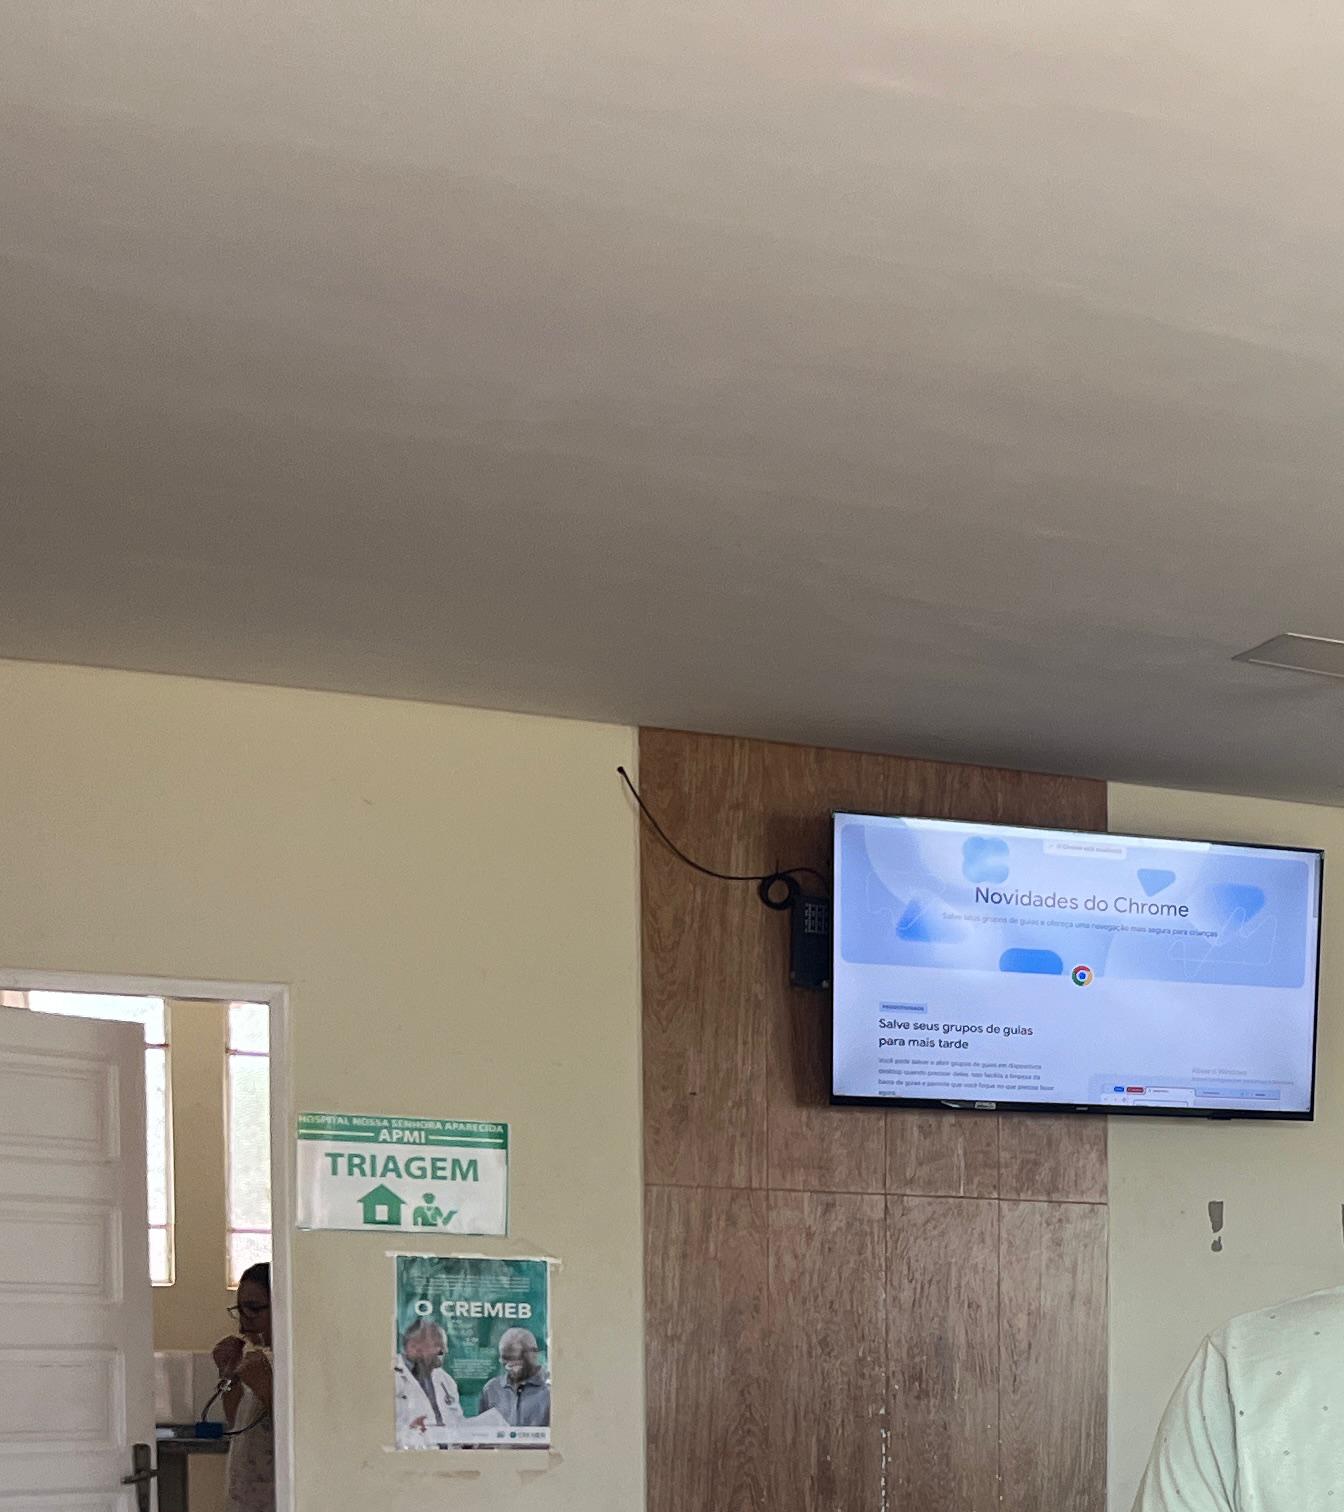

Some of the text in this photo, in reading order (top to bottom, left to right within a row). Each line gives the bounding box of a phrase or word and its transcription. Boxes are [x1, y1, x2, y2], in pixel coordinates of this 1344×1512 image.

[975, 887, 1189, 918] Novidades do Chrome
[879, 1018, 1033, 1037] Salve seus grupos de guias
[879, 1037, 969, 1049] para mais tarde
[298, 1114, 504, 1133] HOSPITAL NOSSA SENHORA APARECIDA
[378, 1129, 426, 1143] APMI
[325, 1151, 479, 1182] TRIAGEM
[414, 1300, 532, 1319] O CREMEB
